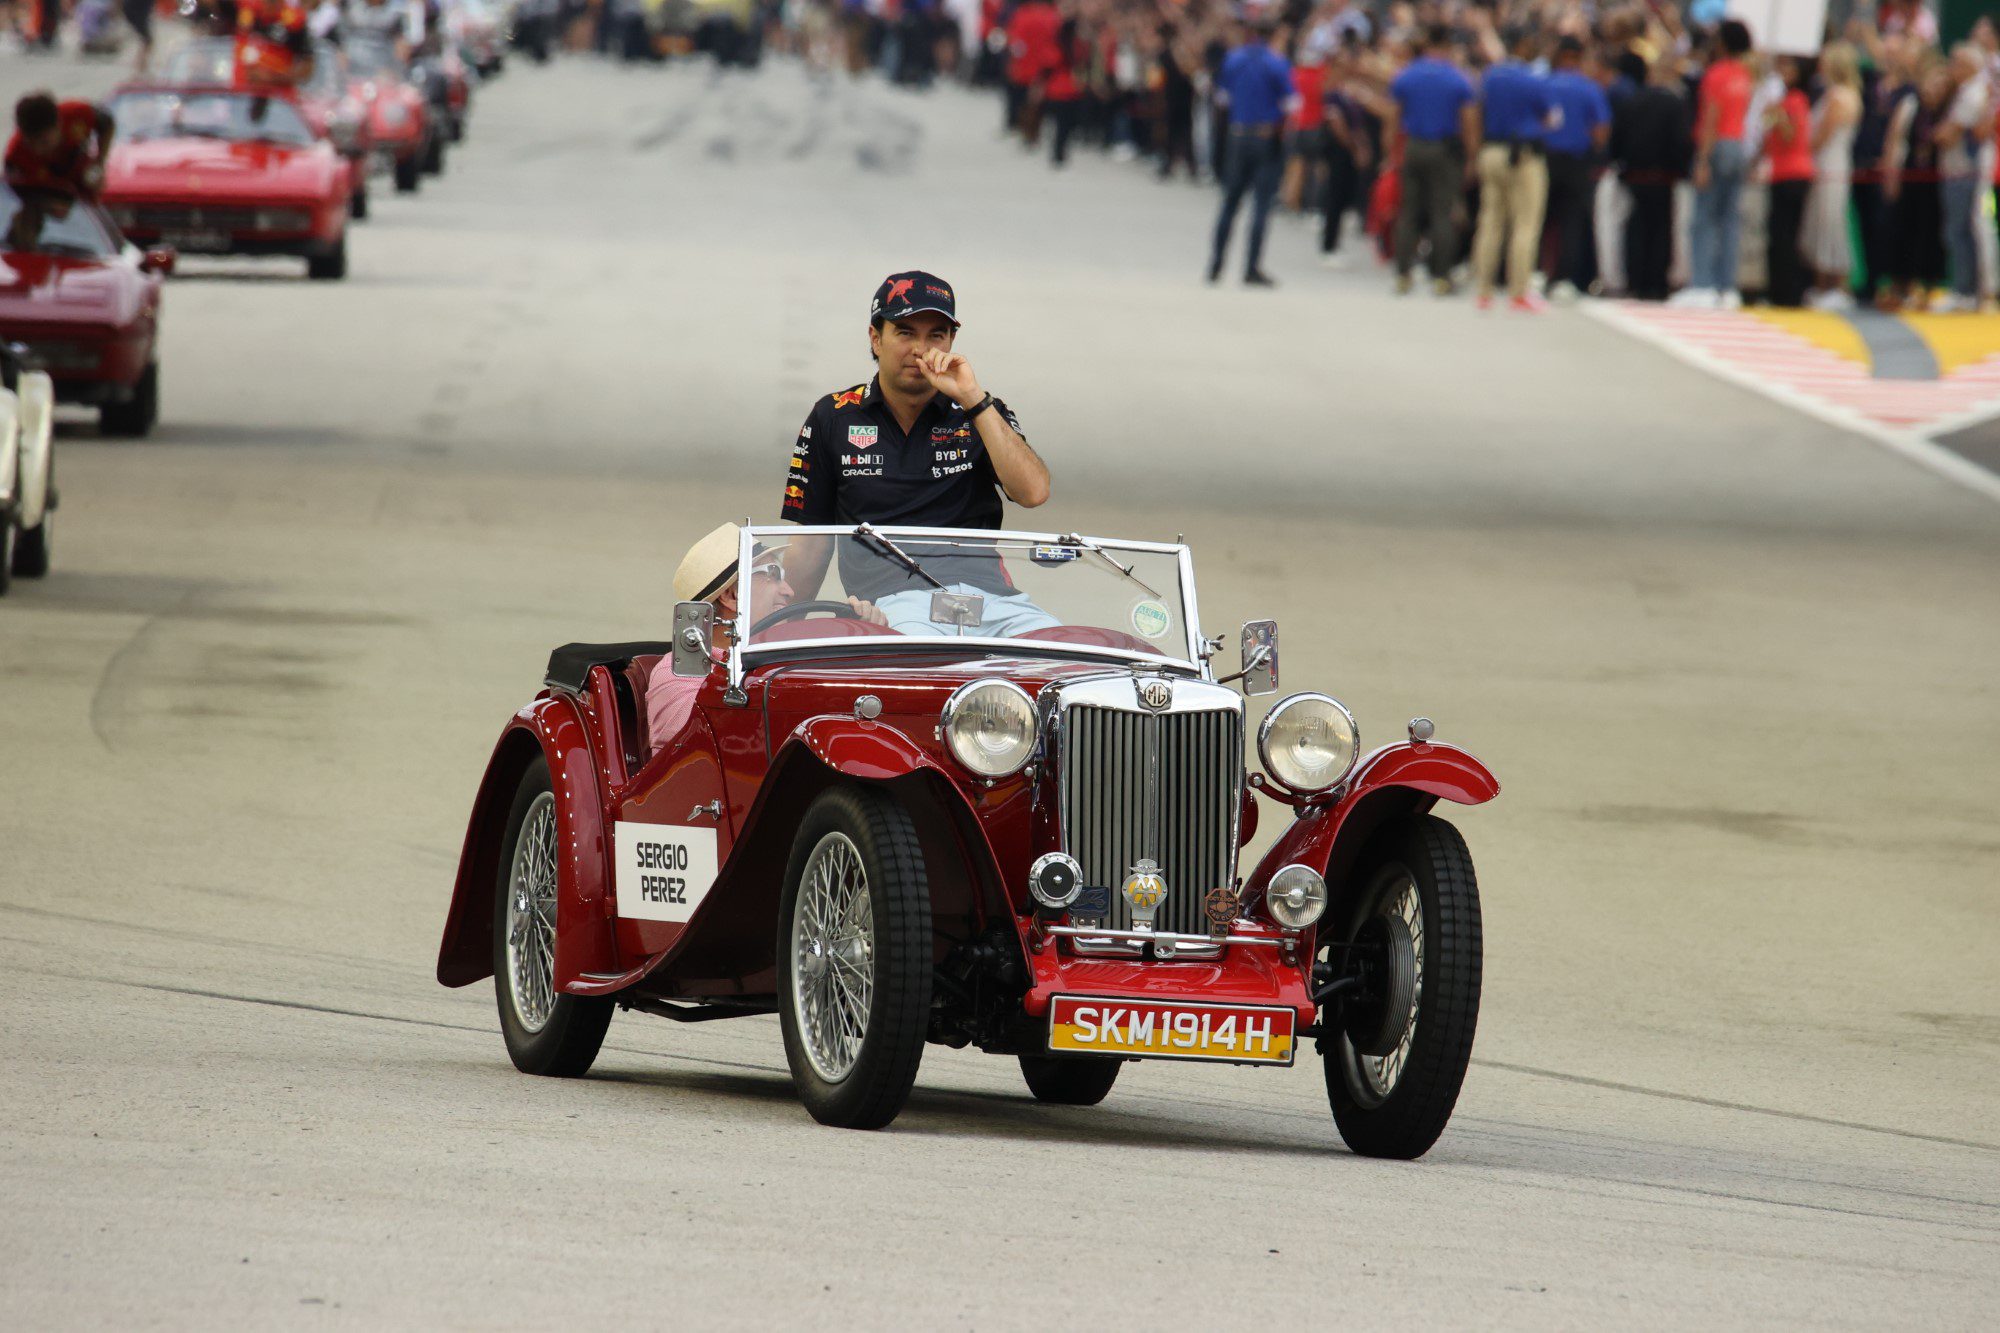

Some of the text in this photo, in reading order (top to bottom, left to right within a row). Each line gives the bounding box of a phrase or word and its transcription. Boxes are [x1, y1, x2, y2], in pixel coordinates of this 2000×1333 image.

[851, 427, 876, 435] TAG
[841, 454, 871, 465] Mobil
[935, 448, 967, 461] BYBIT
[842, 468, 883, 477] ORACLE
[943, 462, 973, 475] Tezos
[1148, 685, 1166, 704] MG
[636, 842, 688, 871] SERGIO
[641, 875, 687, 904] PEREZ
[1072, 1007, 1272, 1052] SKM1914H
